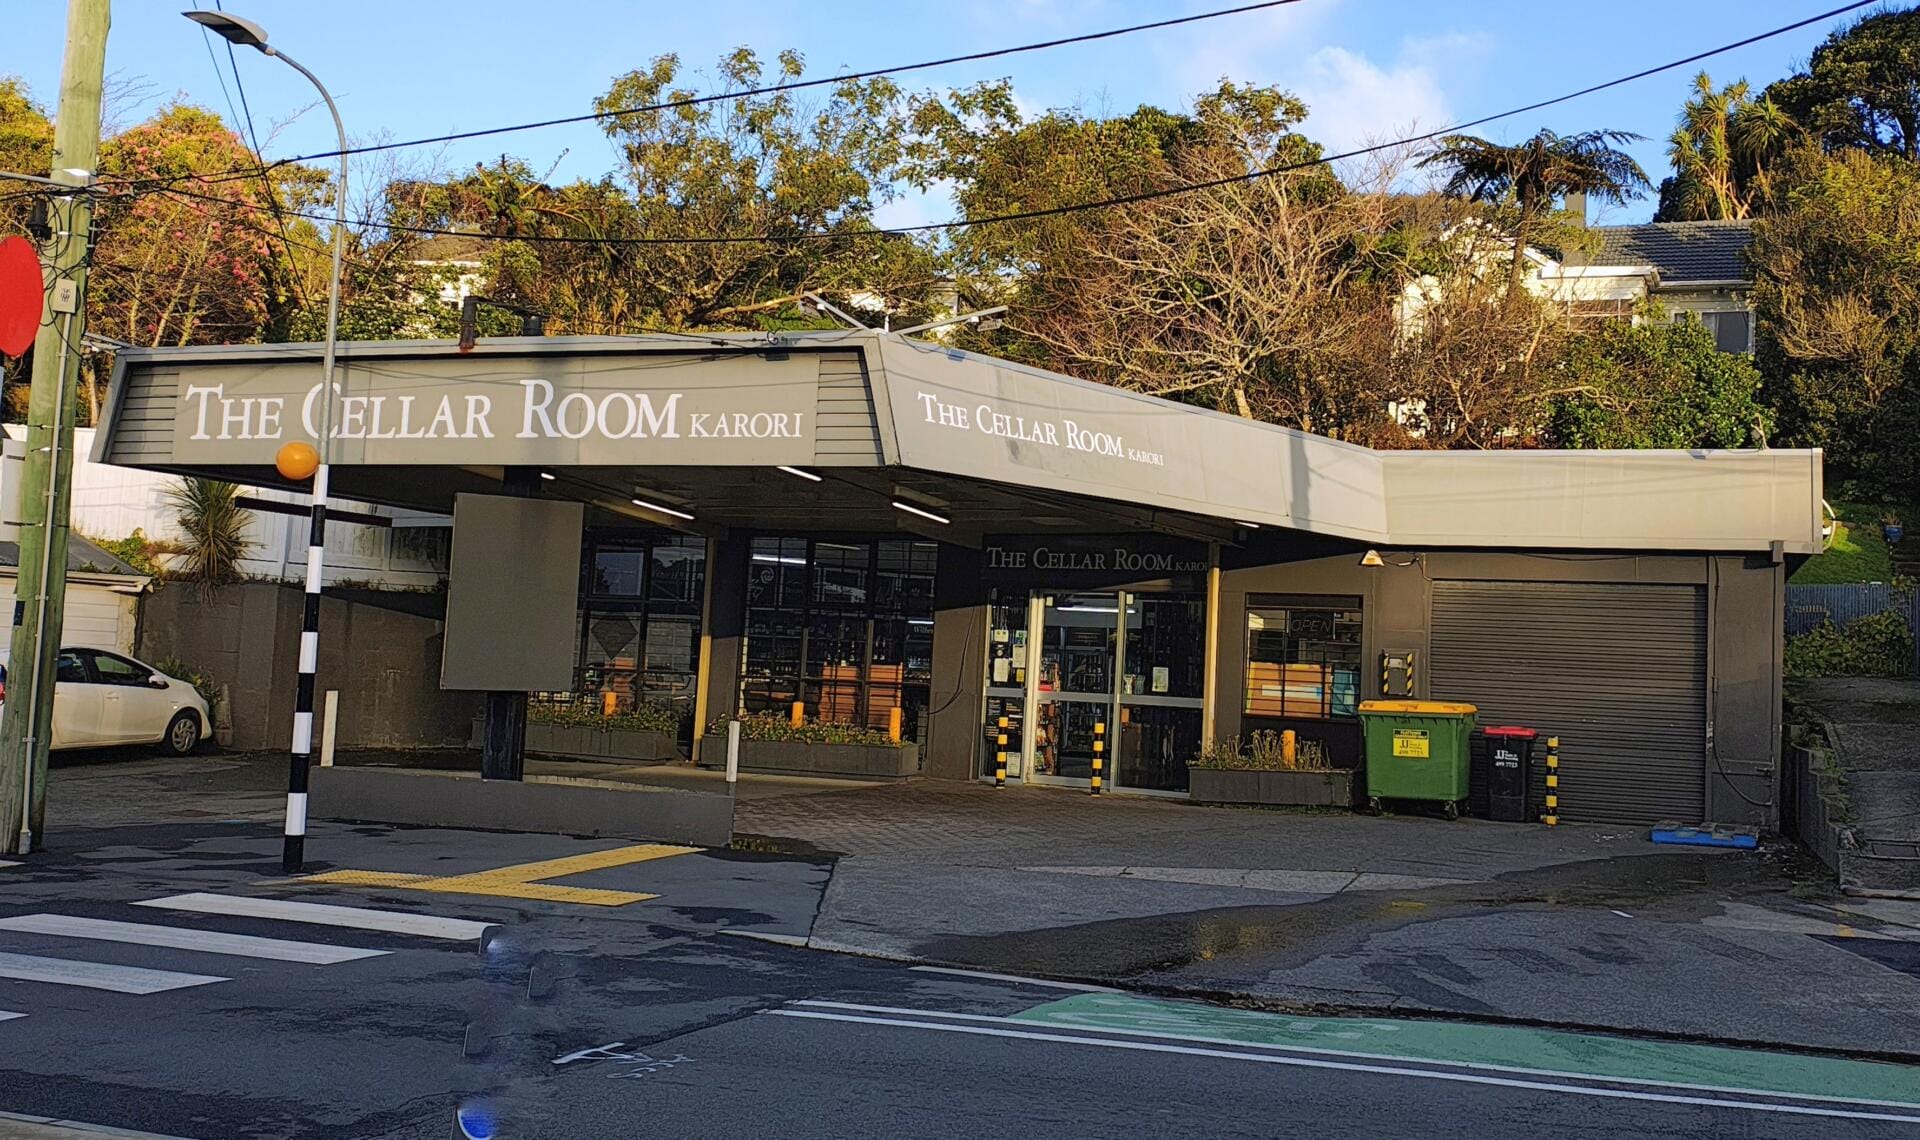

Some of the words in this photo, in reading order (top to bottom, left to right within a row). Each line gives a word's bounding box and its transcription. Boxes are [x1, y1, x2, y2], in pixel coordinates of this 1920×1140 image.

[185, 383, 284, 440] THE
[301, 382, 495, 440] CELLAR
[515, 379, 684, 440] ROOM
[688, 412, 804, 439] KARORI
[917, 391, 970, 430] THE
[976, 404, 1060, 446] CELLAR
[1063, 419, 1125, 458] ROOM
[1127, 447, 1165, 466] KARORI
[986, 546, 1027, 569] THE
[1032, 547, 1107, 570] CELLAR
[1113, 548, 1174, 572] ROOM
[1291, 619, 1332, 633] OPEN
